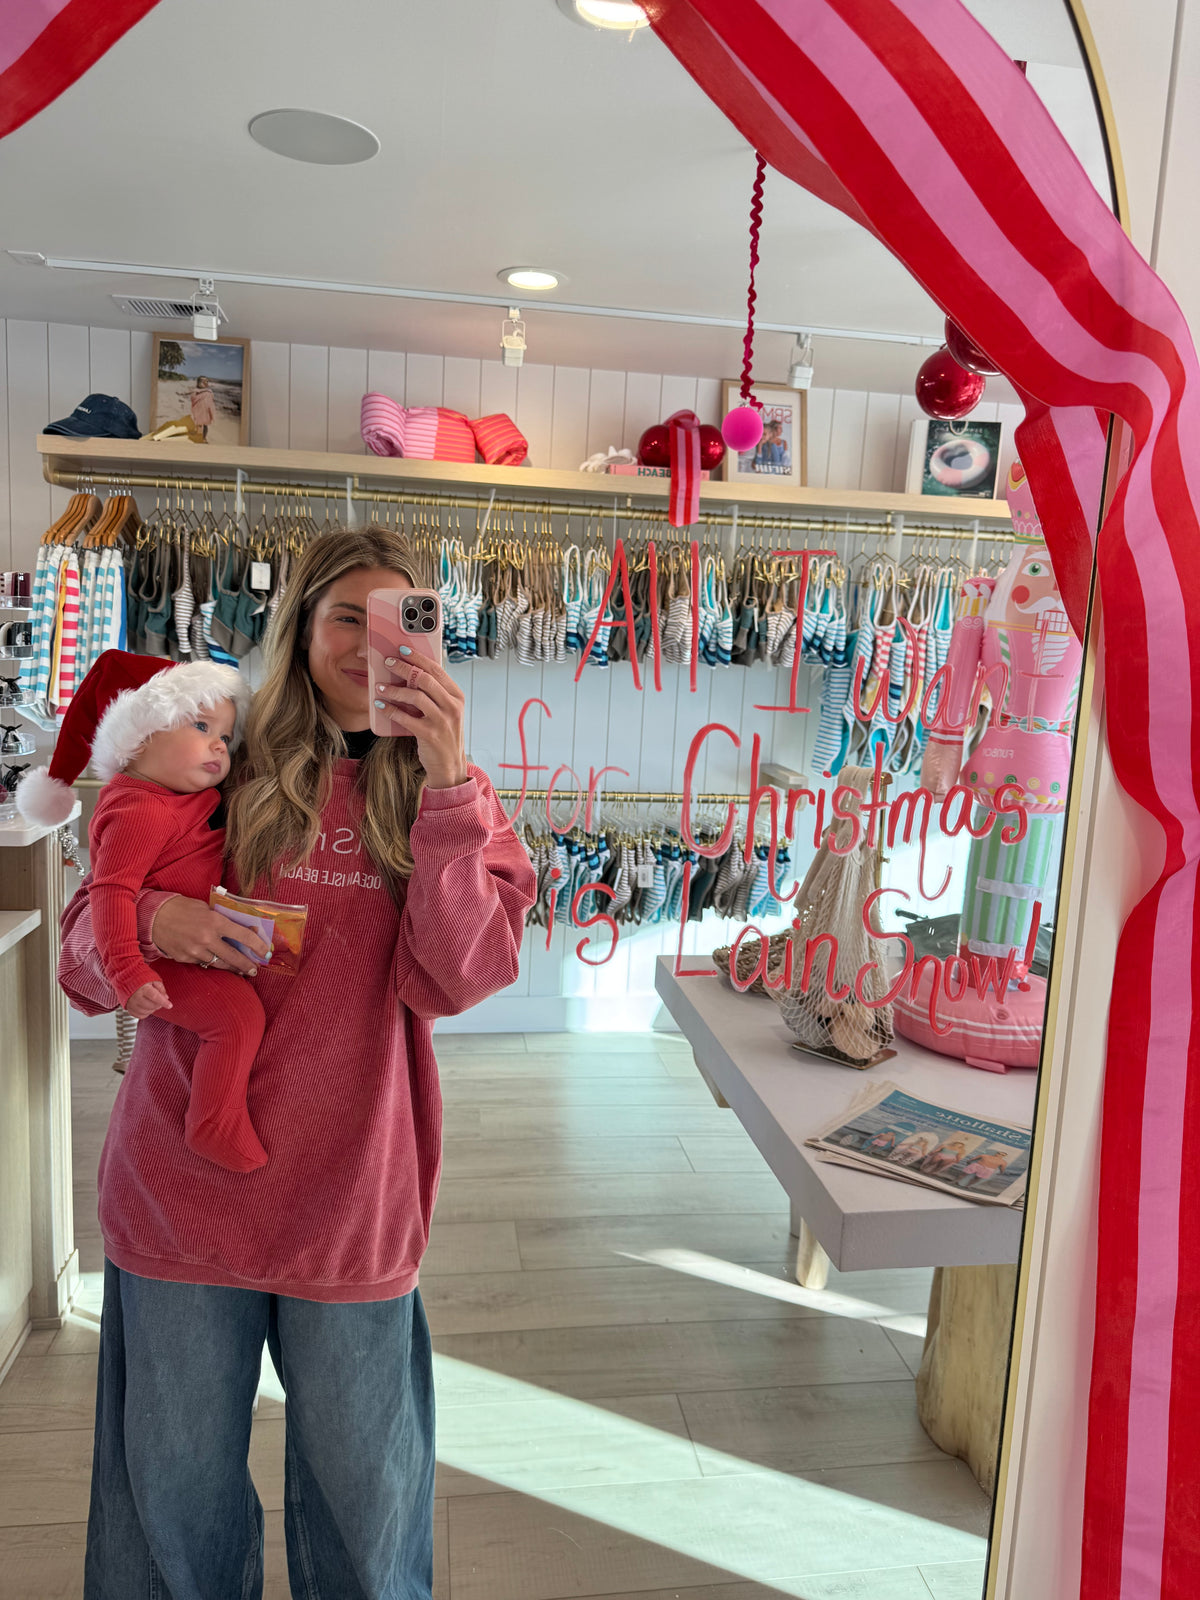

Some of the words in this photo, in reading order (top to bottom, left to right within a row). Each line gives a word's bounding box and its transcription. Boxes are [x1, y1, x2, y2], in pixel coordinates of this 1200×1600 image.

[575, 538, 699, 692] All
[753, 549, 837, 713] I
[478, 698, 630, 834] for
[683, 722, 1029, 902] Christmas
[545, 868, 619, 965] is
